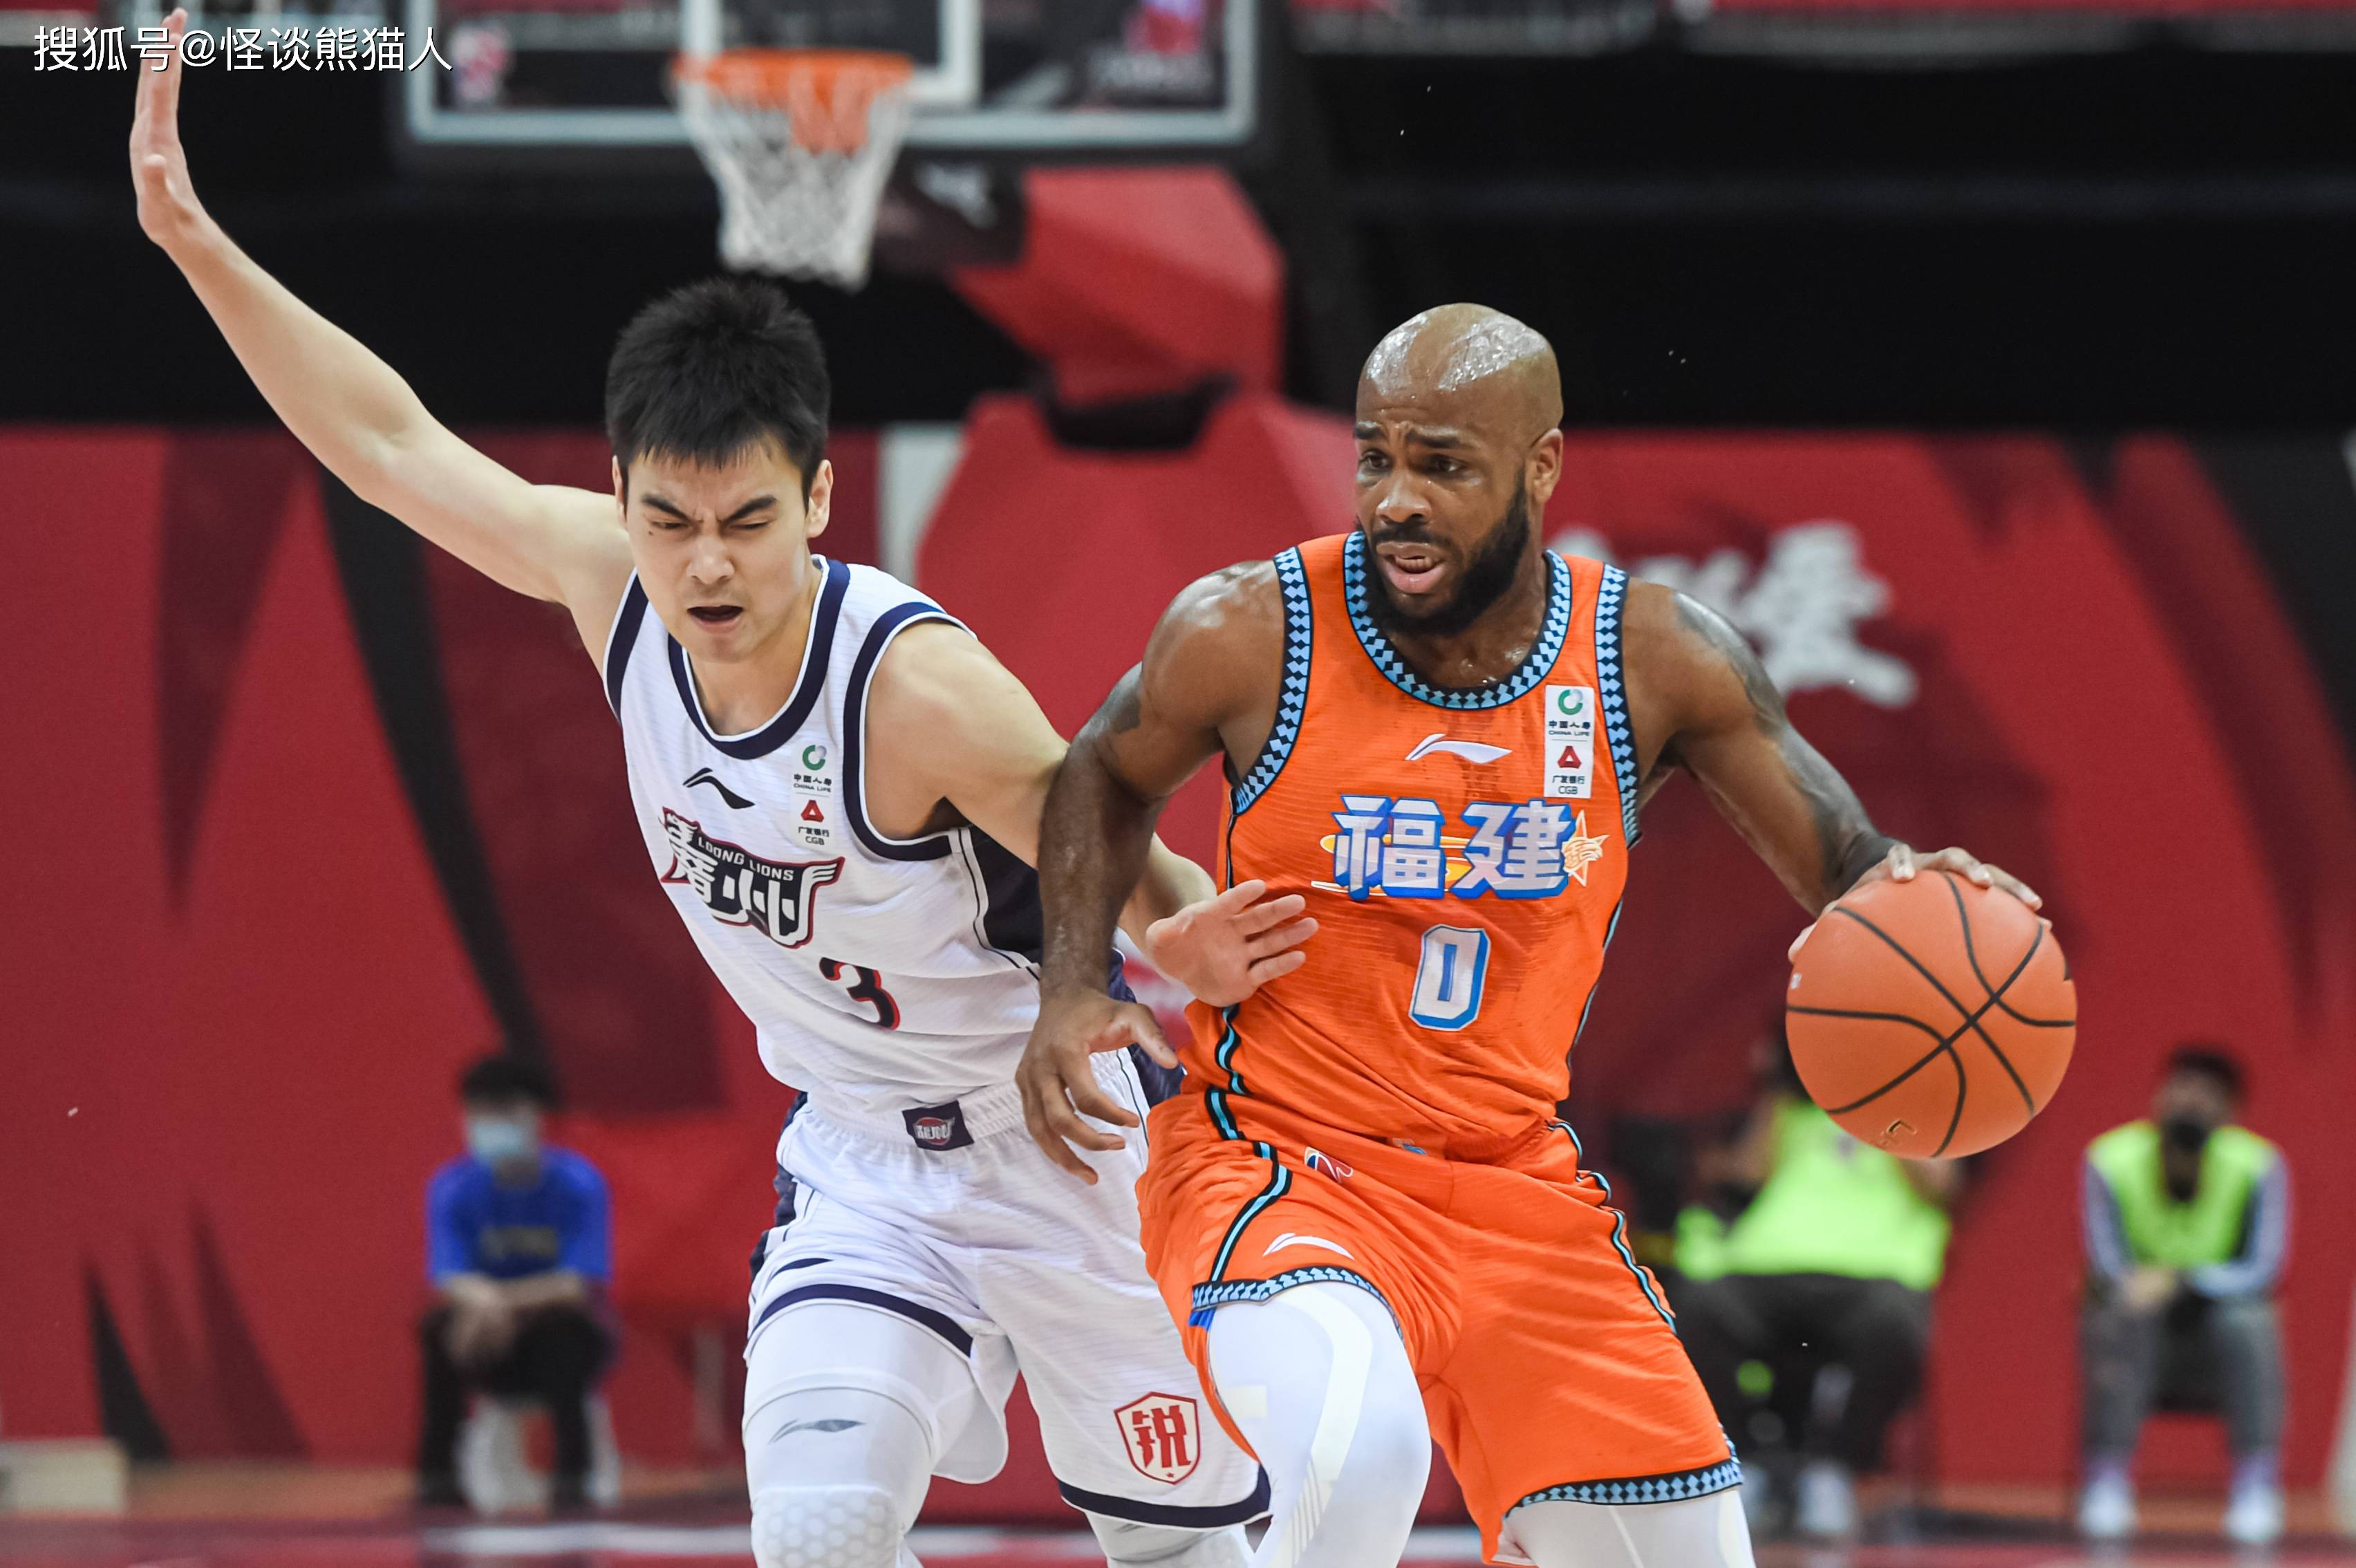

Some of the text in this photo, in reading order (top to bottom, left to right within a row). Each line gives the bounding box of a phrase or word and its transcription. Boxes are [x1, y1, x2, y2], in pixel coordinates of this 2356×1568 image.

[1558, 785, 1578, 794] CGB
[698, 835, 794, 881] LOONG LIONS
[805, 836, 825, 846] CGB
[1332, 795, 1576, 900] 福建
[819, 956, 900, 1030] 3
[1408, 924, 1490, 1031] 0
